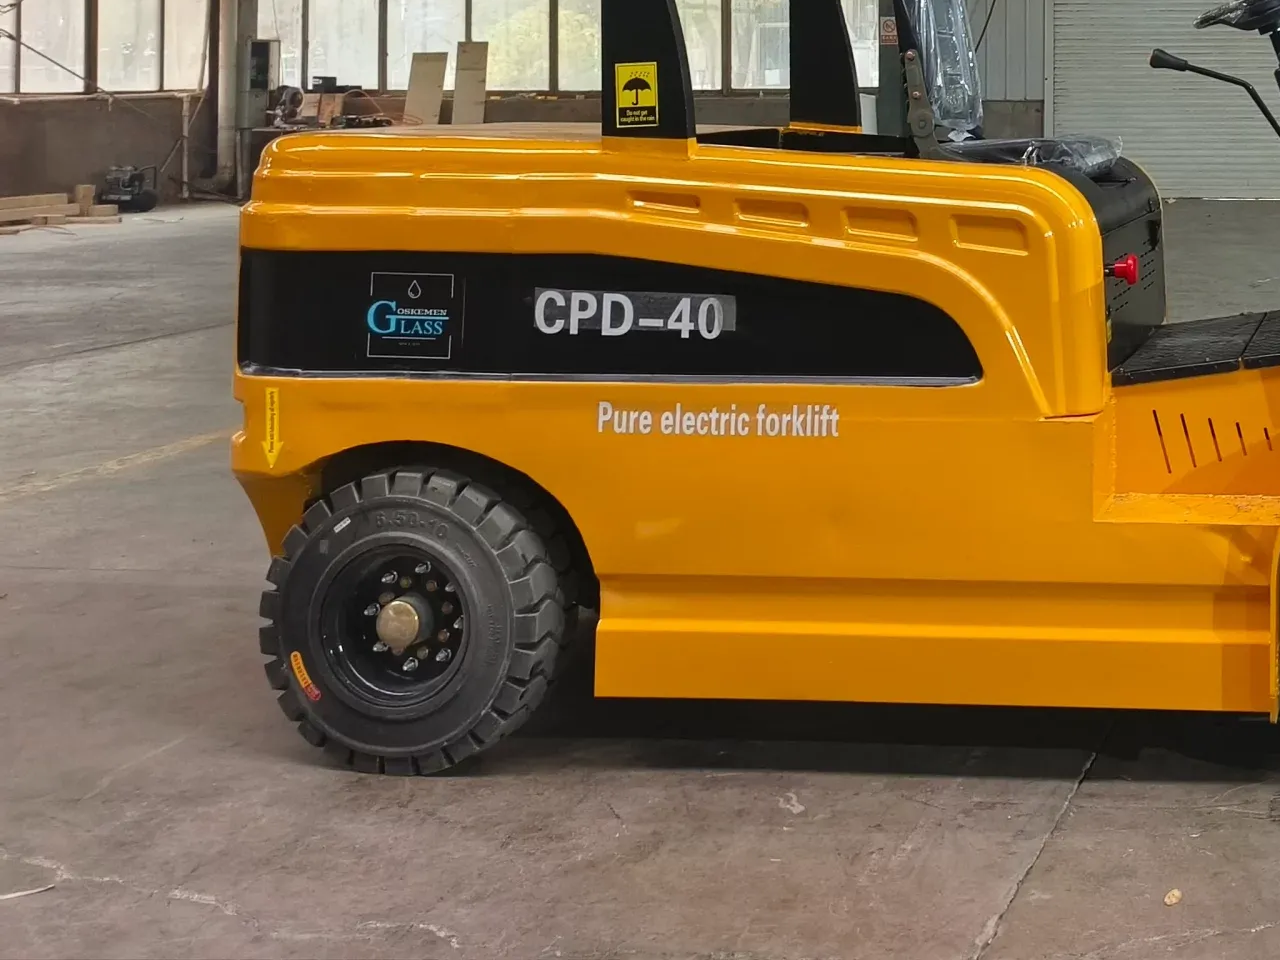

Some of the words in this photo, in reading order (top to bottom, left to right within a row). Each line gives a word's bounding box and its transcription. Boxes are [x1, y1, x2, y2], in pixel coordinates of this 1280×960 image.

[534, 290, 724, 340] CPD-40
[597, 401, 652, 434] Pure
[660, 403, 750, 436] electric
[756, 403, 840, 437] forklift
